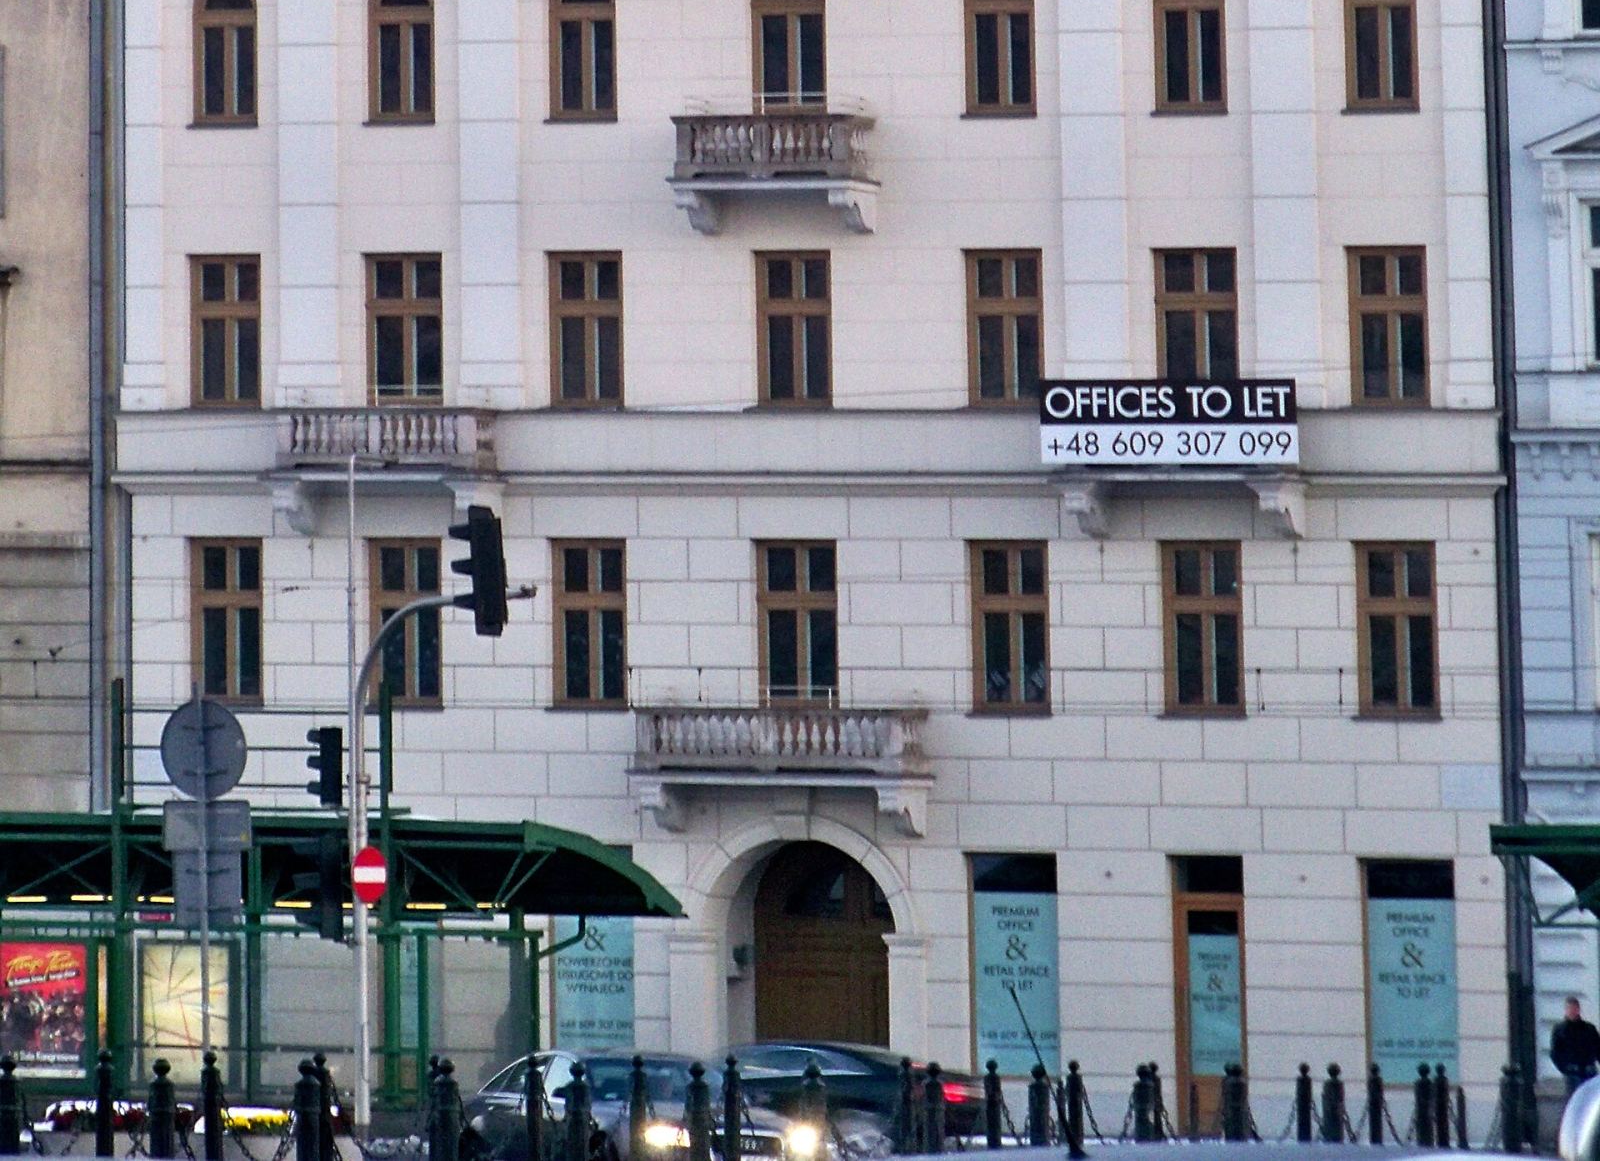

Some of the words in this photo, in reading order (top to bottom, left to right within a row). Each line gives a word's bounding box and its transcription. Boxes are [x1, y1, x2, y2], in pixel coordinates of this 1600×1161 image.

[1045, 386, 1176, 419] OFFICES
[1186, 386, 1232, 418] TO
[1243, 386, 1291, 418] LET
[1047, 431, 1100, 457] +48
[1112, 431, 1164, 456] 609
[1177, 431, 1226, 456] 307
[1239, 431, 1292, 456] 099
[992, 905, 1040, 916] PREMIUM
[997, 920, 1034, 931] OFFICE
[1392, 926, 1429, 937] OFFICE
[584, 926, 606, 951] &
[1005, 934, 1028, 960] &
[1401, 942, 1424, 968] &
[984, 965, 1014, 976] RETAIL
[1018, 965, 1050, 977] SPACE
[1001, 979, 1016, 990] TO
[1018, 979, 1033, 991] LET
